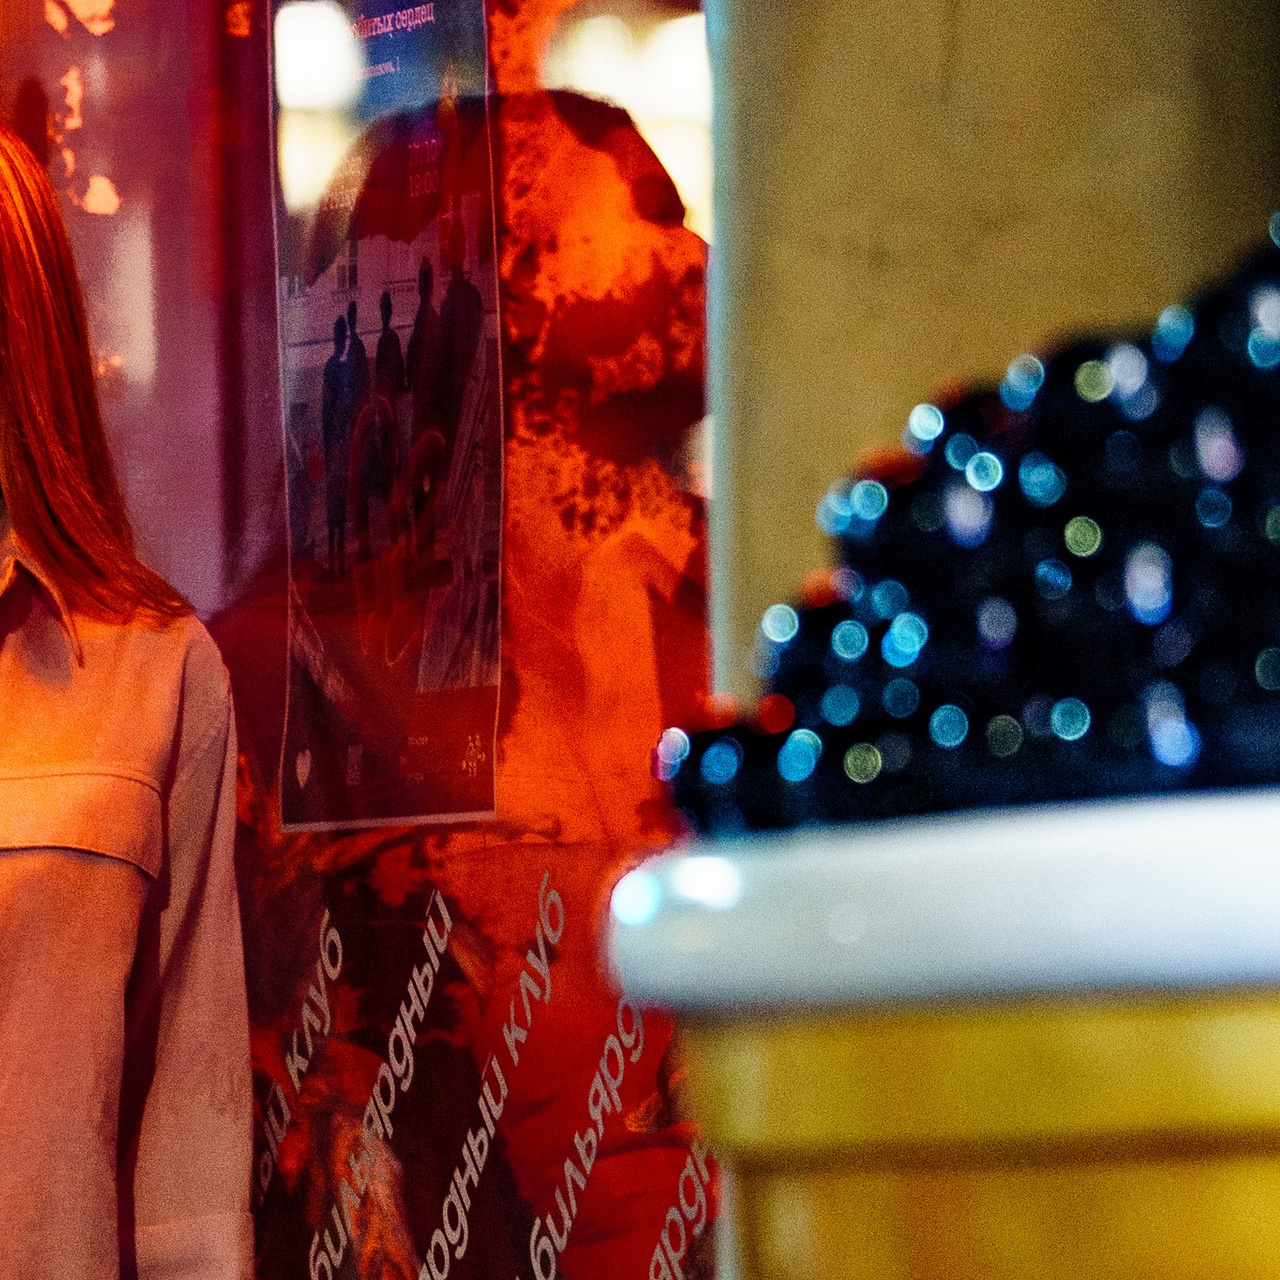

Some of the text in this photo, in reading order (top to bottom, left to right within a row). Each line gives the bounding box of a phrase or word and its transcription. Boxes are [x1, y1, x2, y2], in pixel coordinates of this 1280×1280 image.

[408, 169, 440, 197] 19:00
[284, 906, 344, 1095] клуб
[502, 869, 565, 1067] клуб
